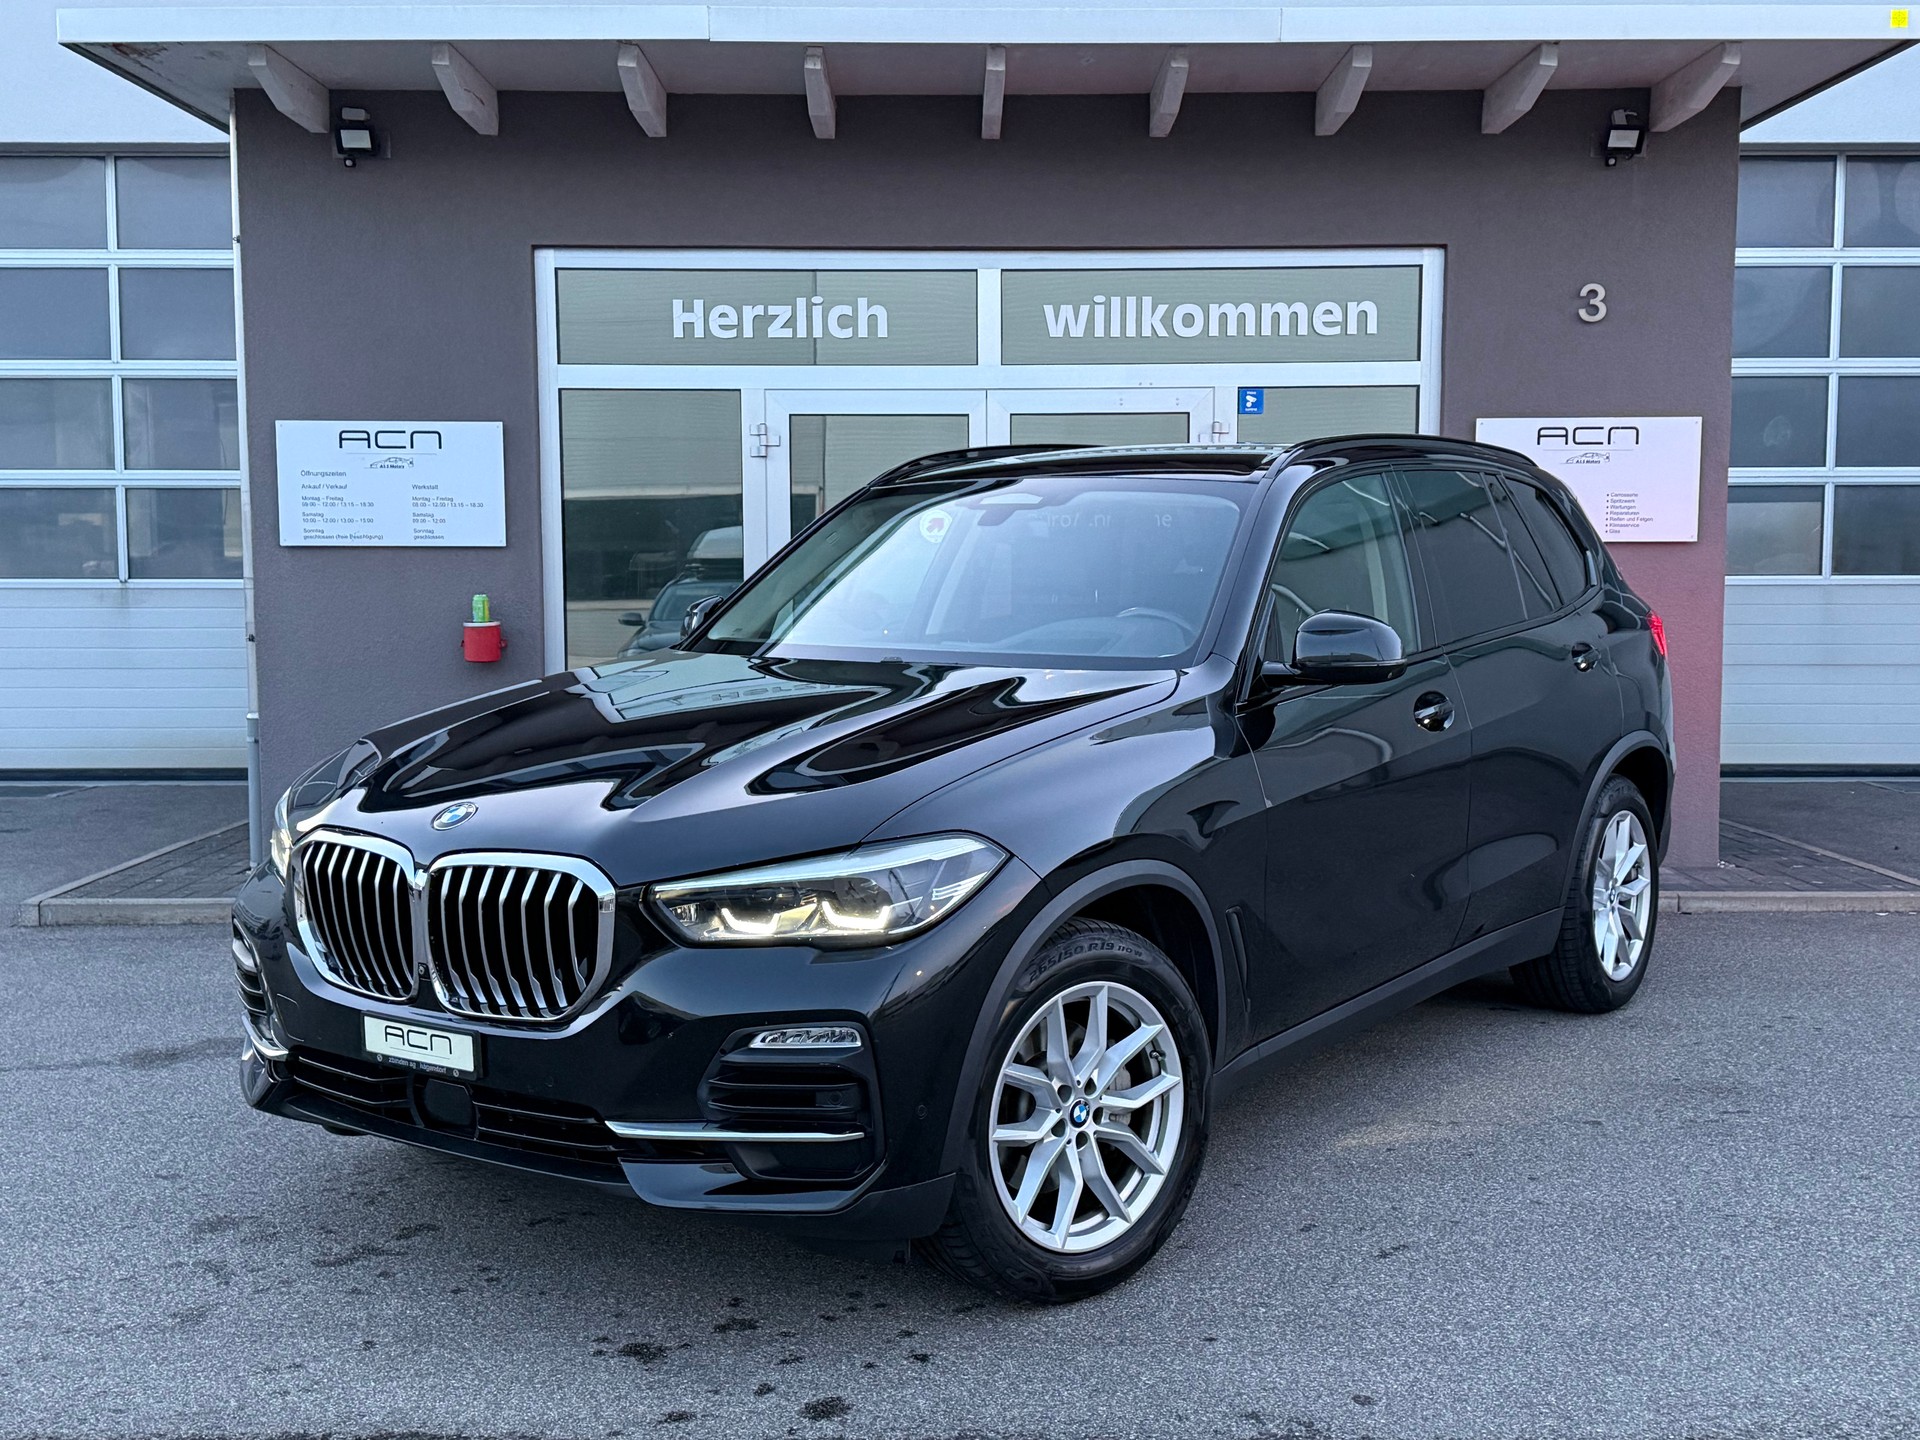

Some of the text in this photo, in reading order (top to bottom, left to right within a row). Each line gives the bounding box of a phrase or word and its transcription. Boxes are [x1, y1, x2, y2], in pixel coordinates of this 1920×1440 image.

[1578, 283, 1607, 323] 3
[672, 295, 1378, 339] Herzlich willkommen
[338, 430, 442, 450] ACN
[1537, 426, 1639, 445] ACN
[300, 469, 347, 477] Öffnungszeiten
[384, 1025, 452, 1055] ACN
